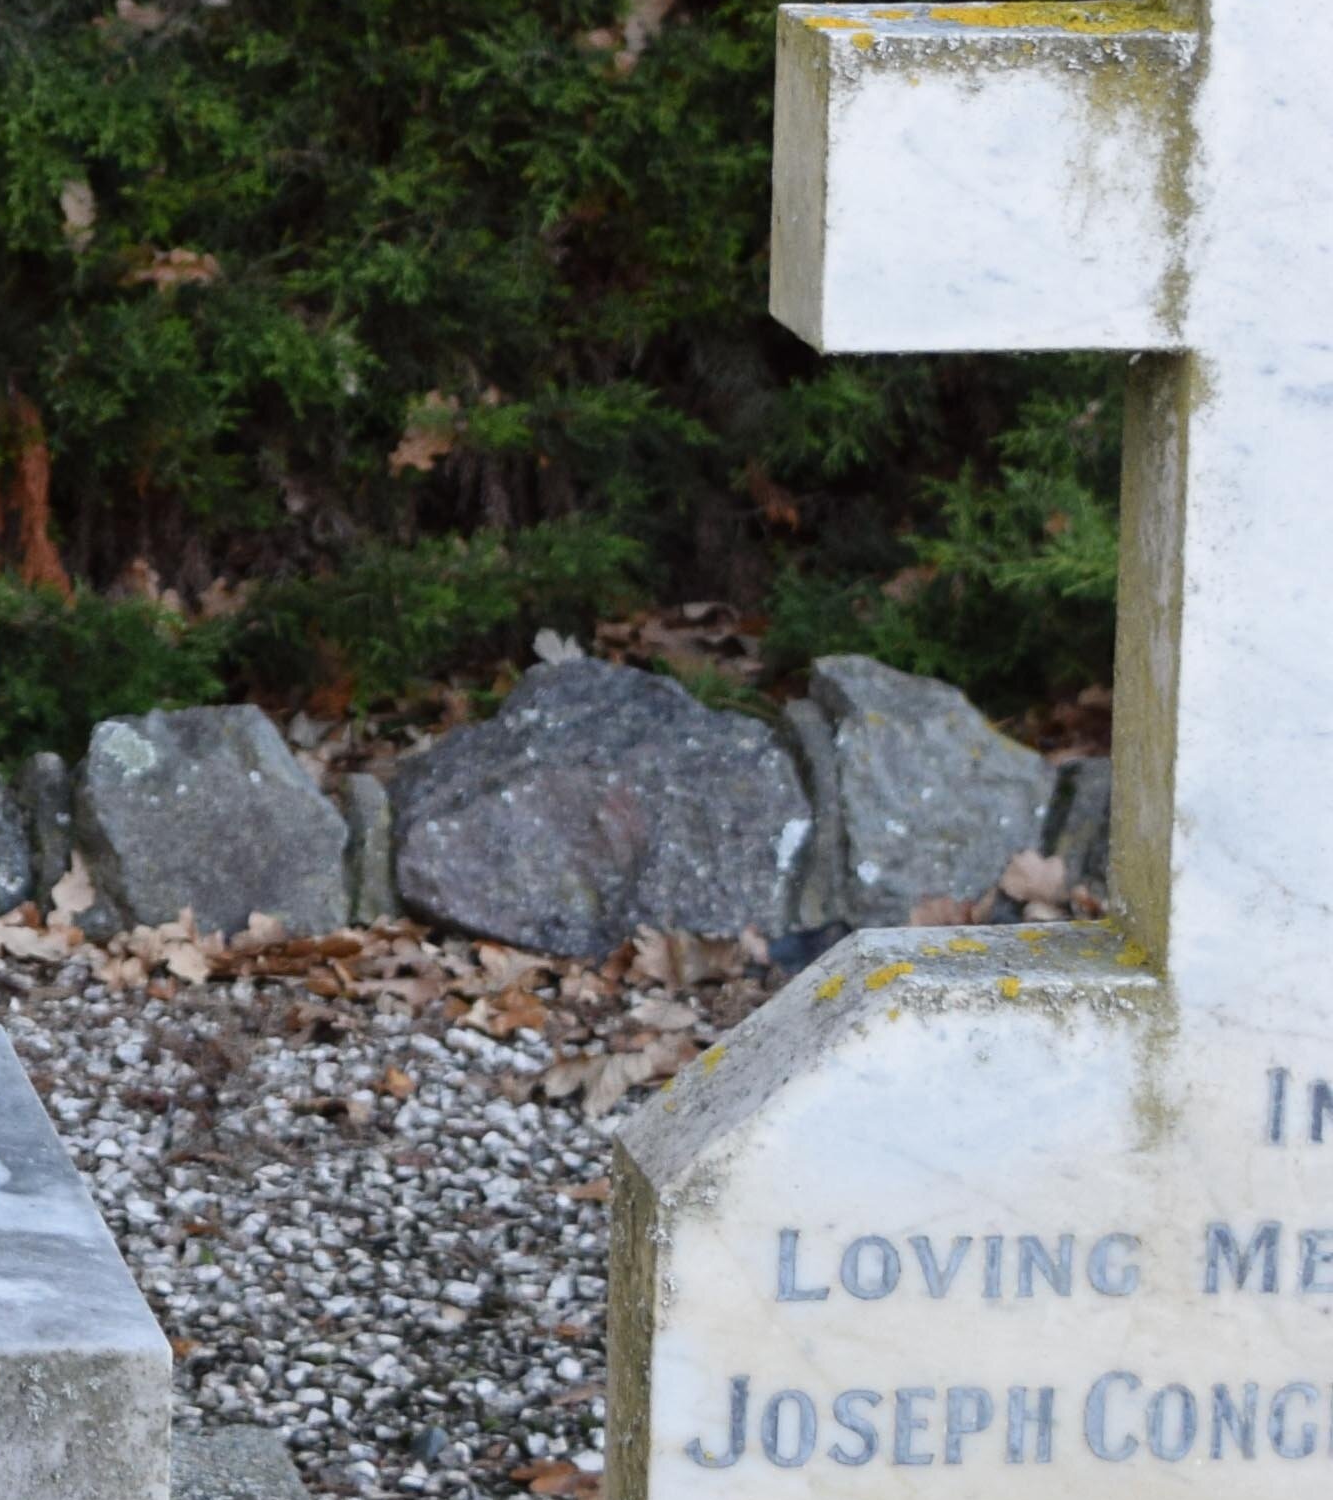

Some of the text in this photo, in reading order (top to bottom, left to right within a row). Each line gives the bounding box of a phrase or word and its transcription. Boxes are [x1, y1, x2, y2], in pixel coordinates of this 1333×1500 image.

[775, 1228, 1141, 1301] LOVING
[686, 1370, 1333, 1467] JOSEPH CONG
